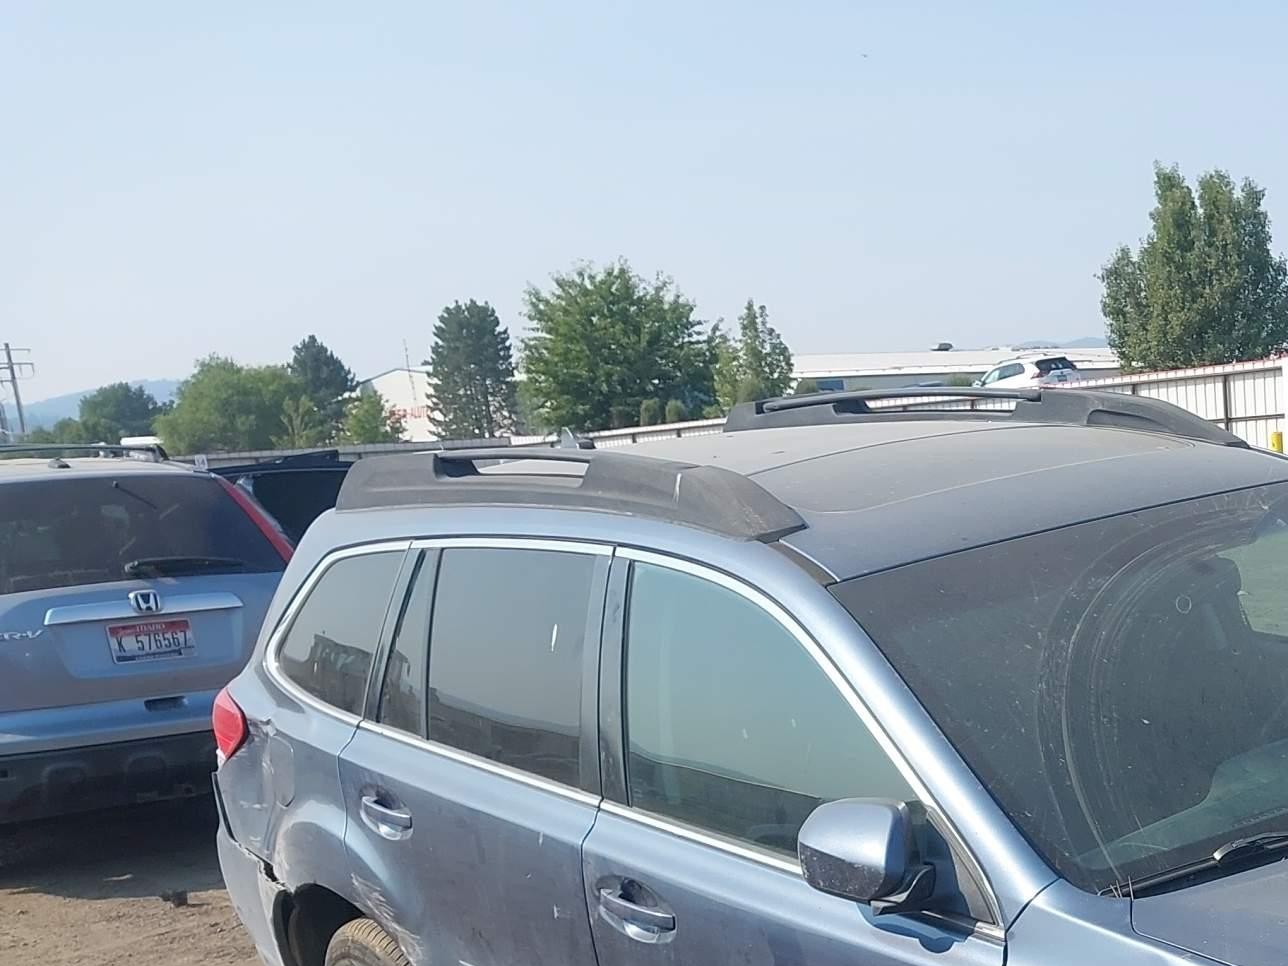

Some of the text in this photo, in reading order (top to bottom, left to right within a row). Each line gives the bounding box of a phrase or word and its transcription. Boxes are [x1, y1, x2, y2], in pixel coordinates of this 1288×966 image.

[0, 629, 44, 640] R-V
[115, 636, 126, 653] K
[135, 630, 188, 652] 576567
